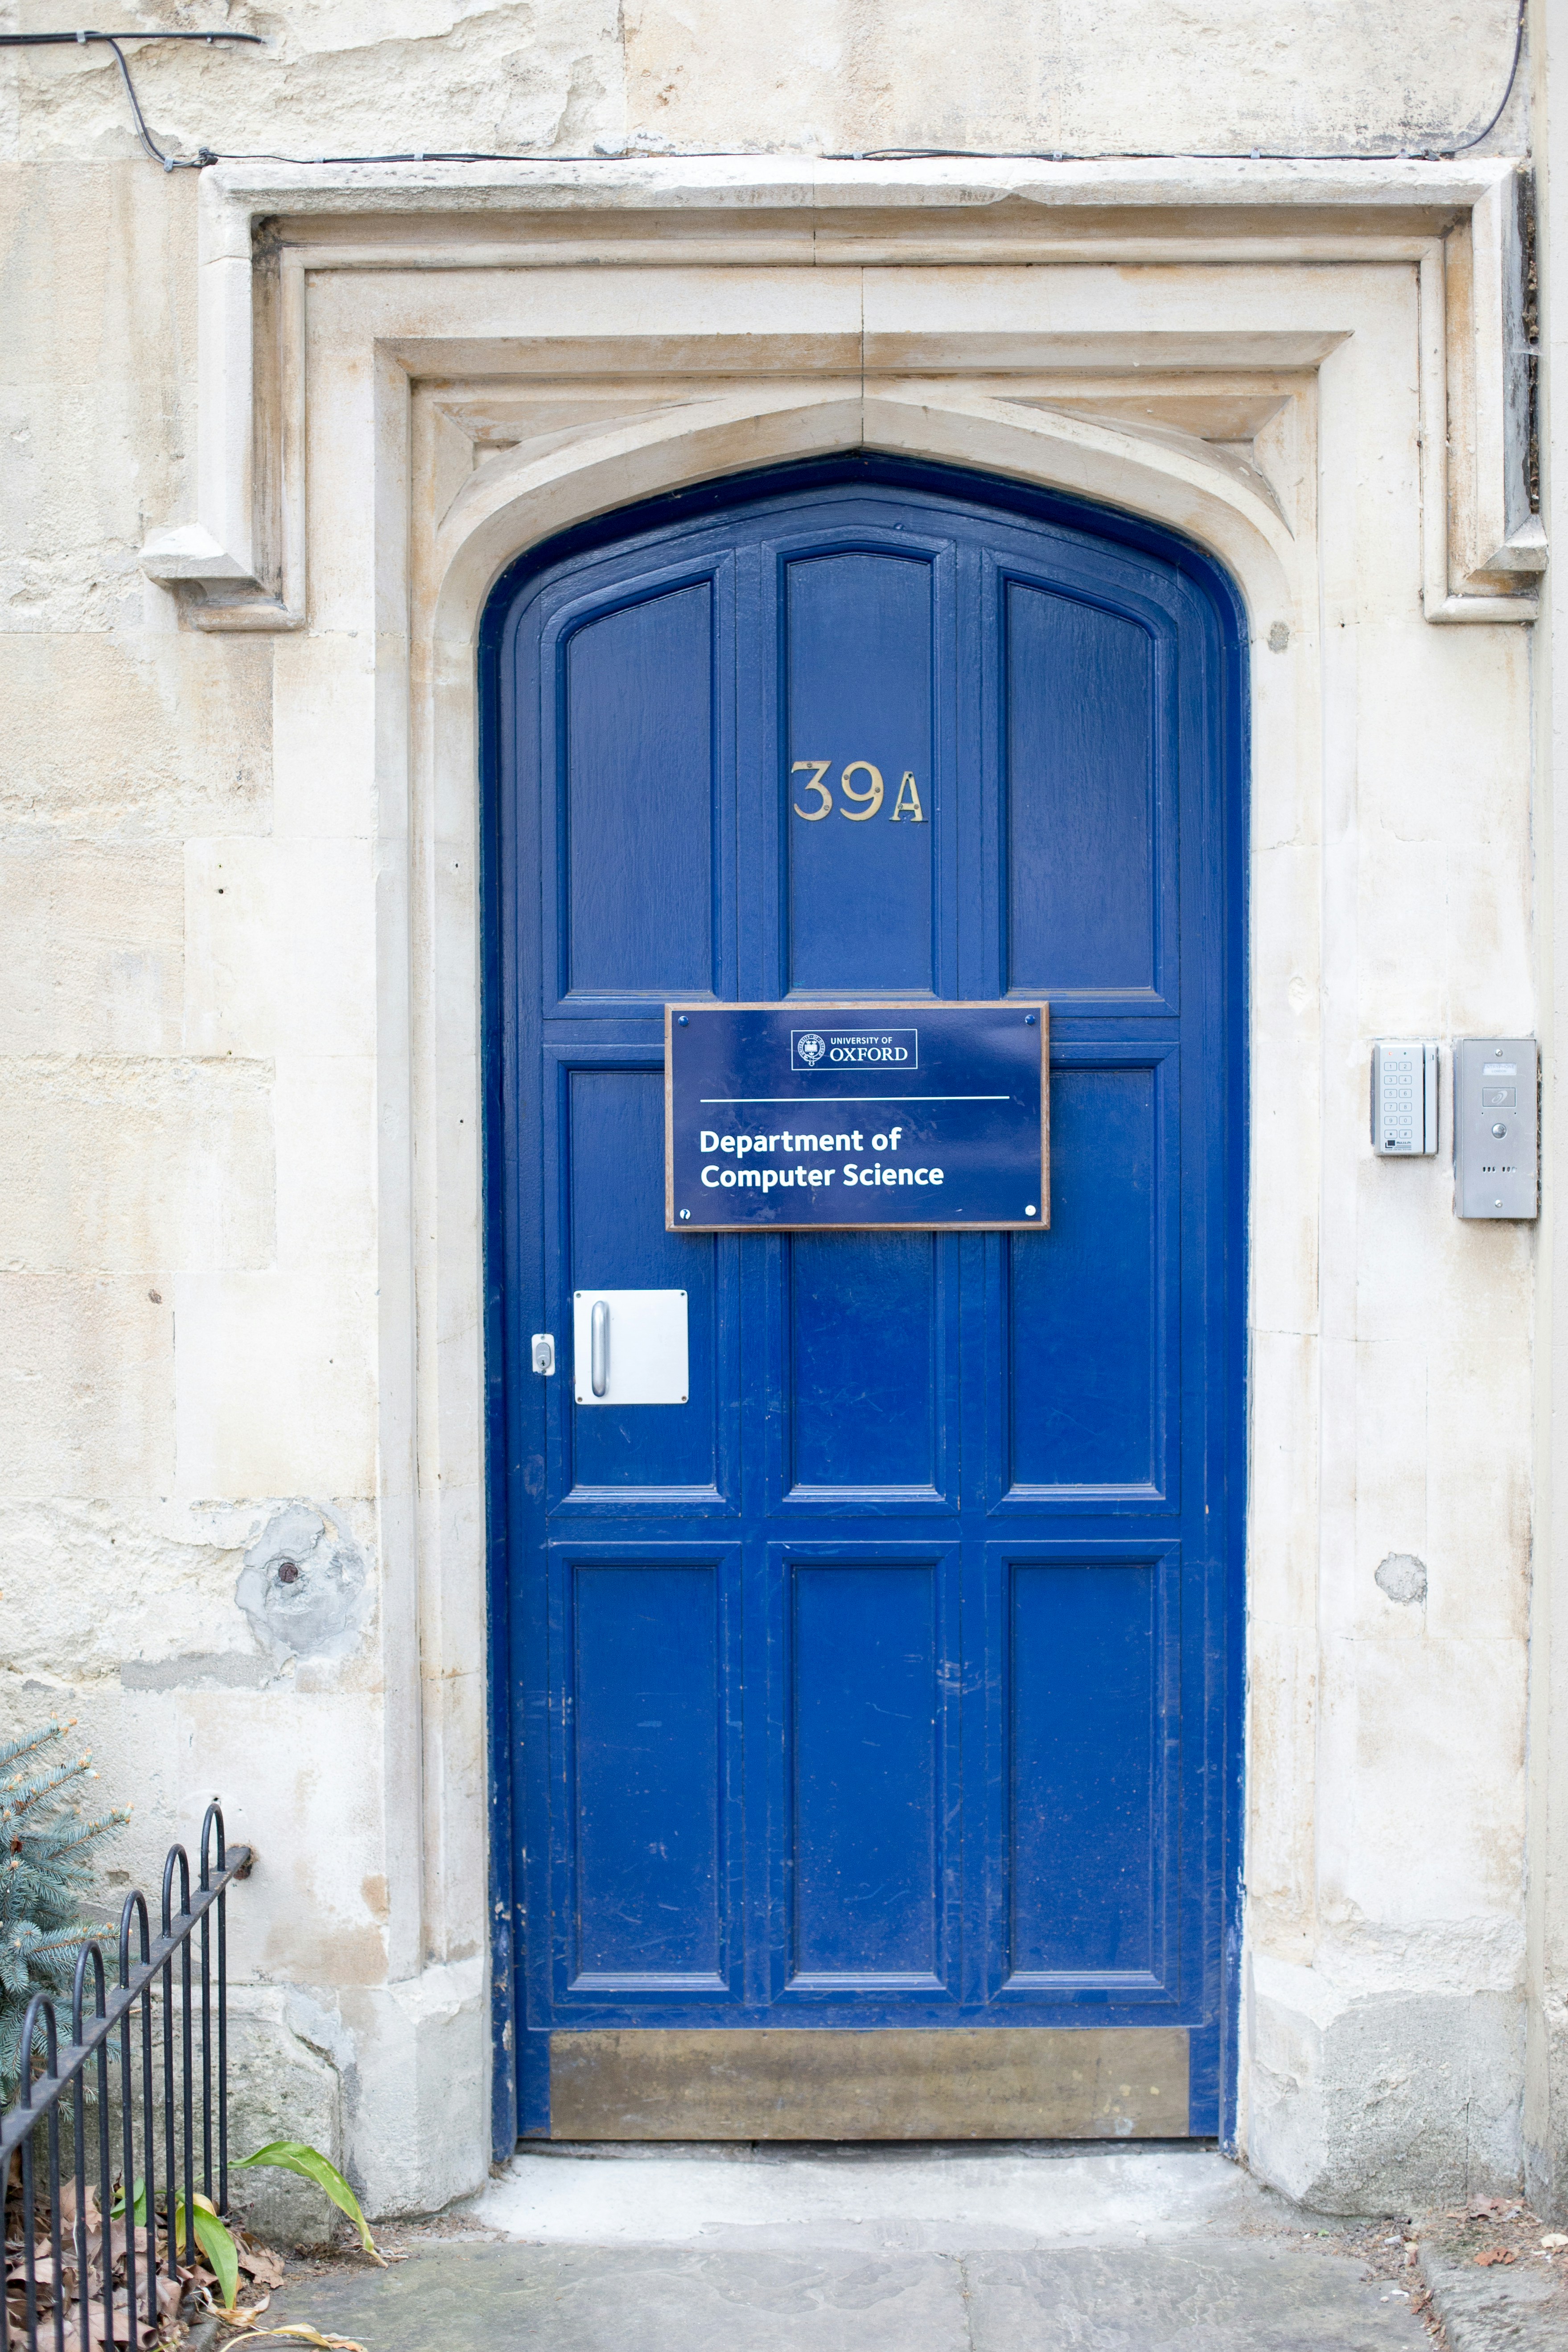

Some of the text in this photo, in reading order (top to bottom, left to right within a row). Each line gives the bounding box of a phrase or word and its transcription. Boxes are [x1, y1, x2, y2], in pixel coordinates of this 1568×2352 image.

[791, 760, 929, 822] 39A
[830, 1047, 908, 1061] OXFORD
[700, 1127, 902, 1158] Department of
[701, 1162, 944, 1193] Computer Science
